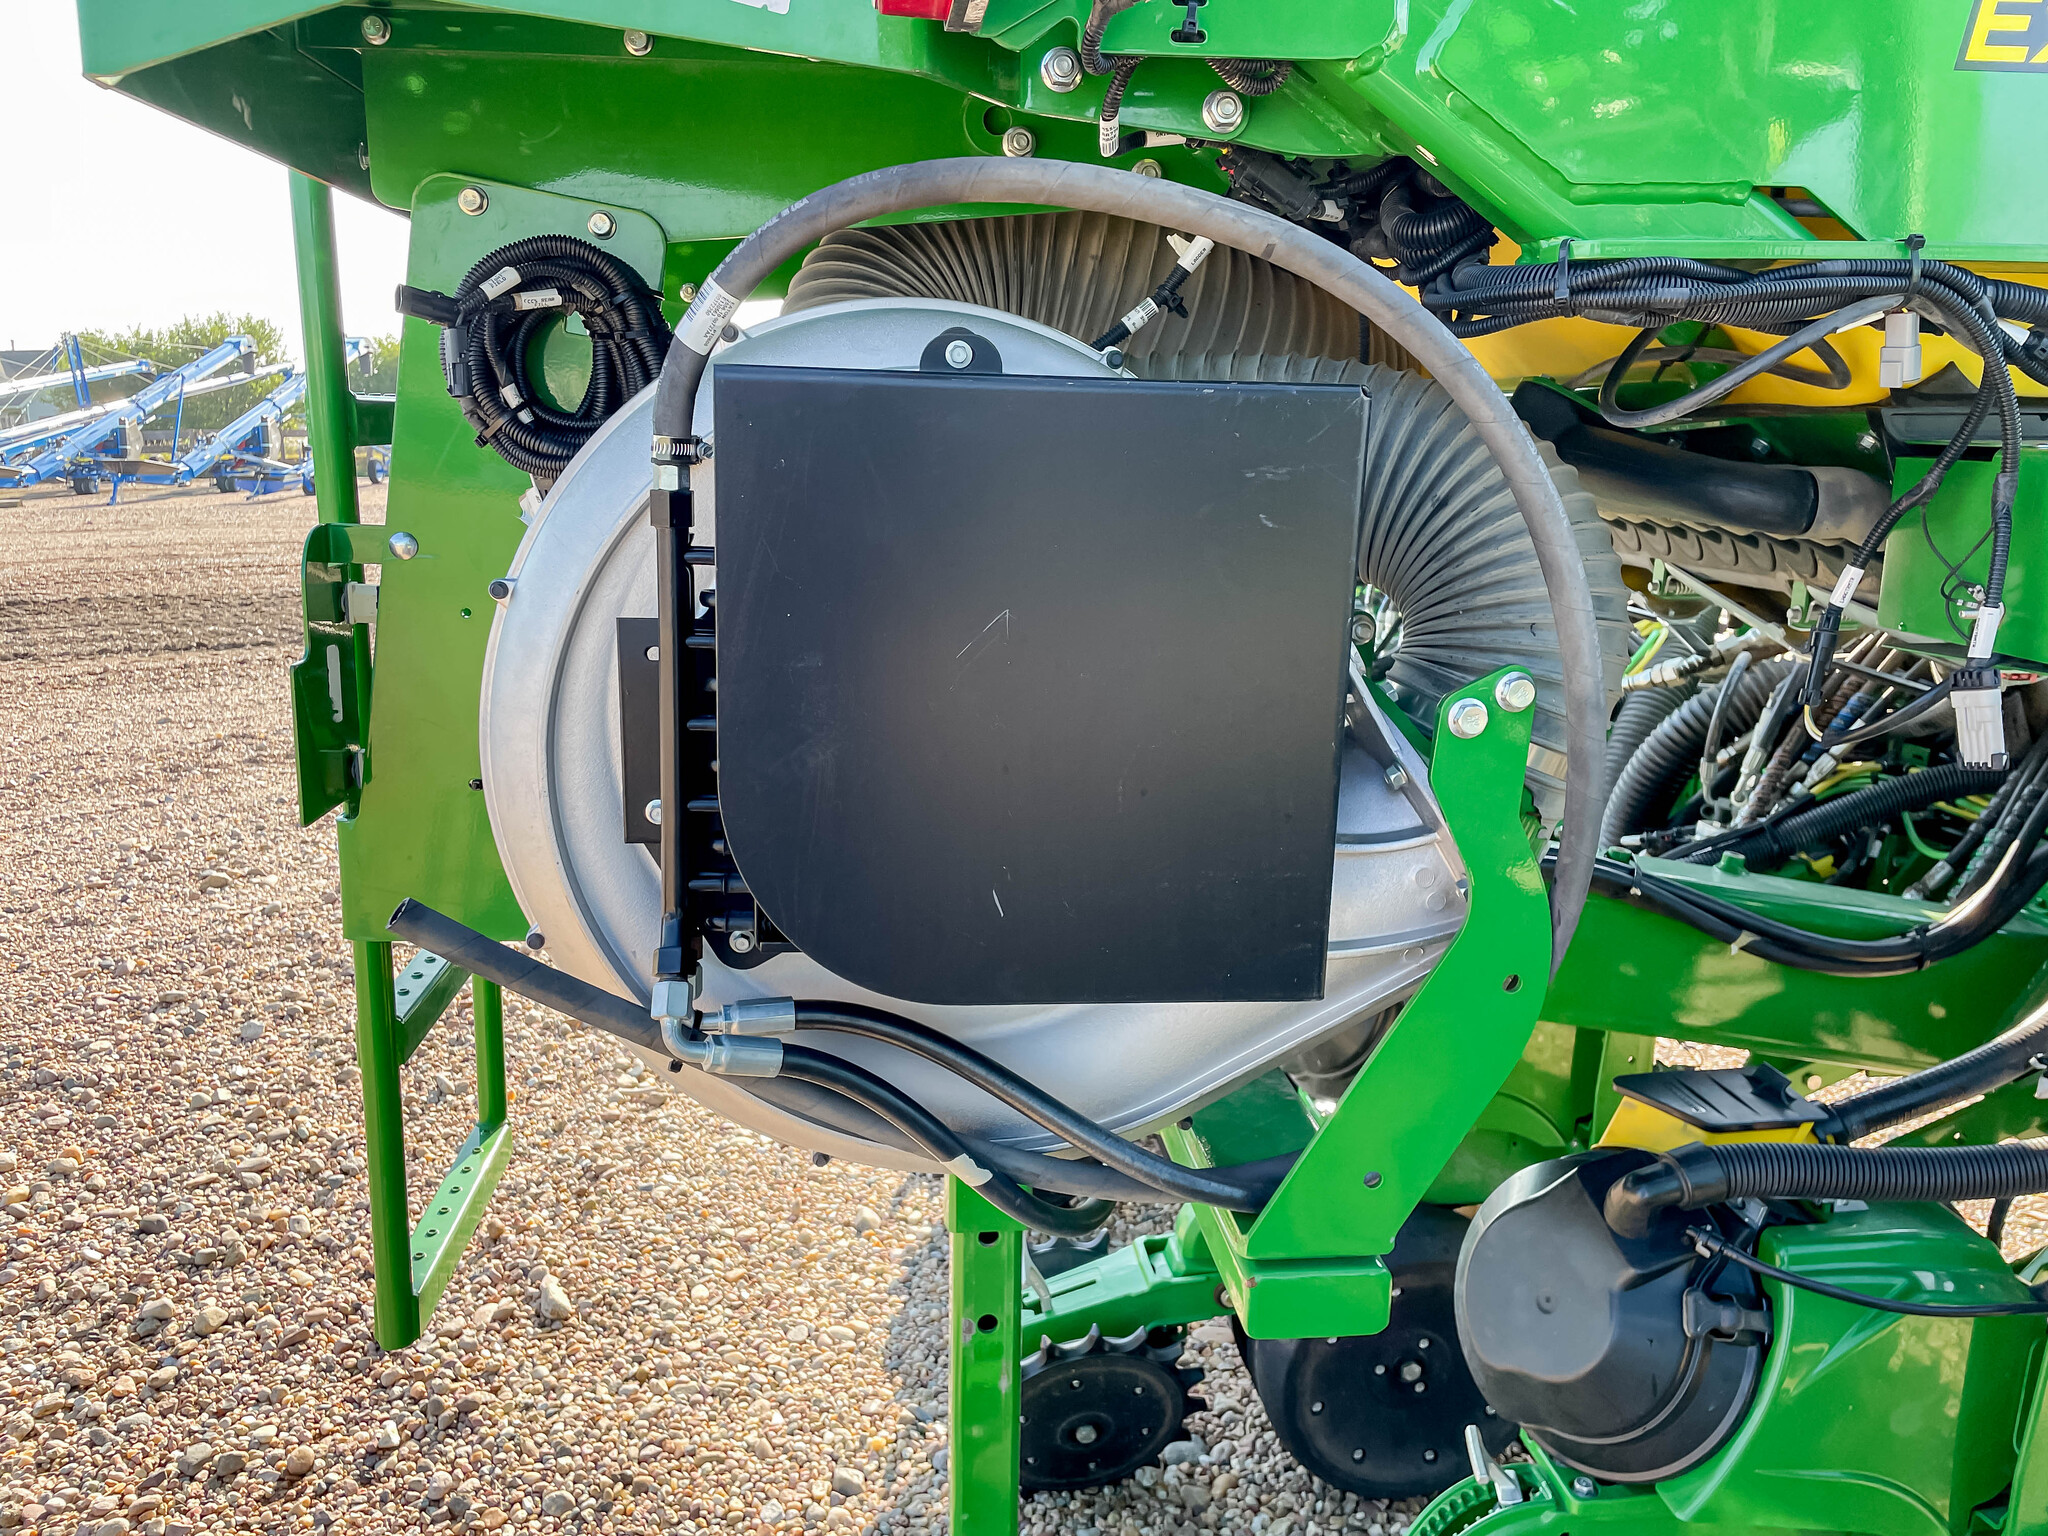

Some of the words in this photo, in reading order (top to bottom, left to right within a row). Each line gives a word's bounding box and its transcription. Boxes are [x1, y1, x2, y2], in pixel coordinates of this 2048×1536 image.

[1965, 0, 2048, 63] E
[1190, 247, 1207, 266] LADDER
[722, 301, 735, 319] EATON
